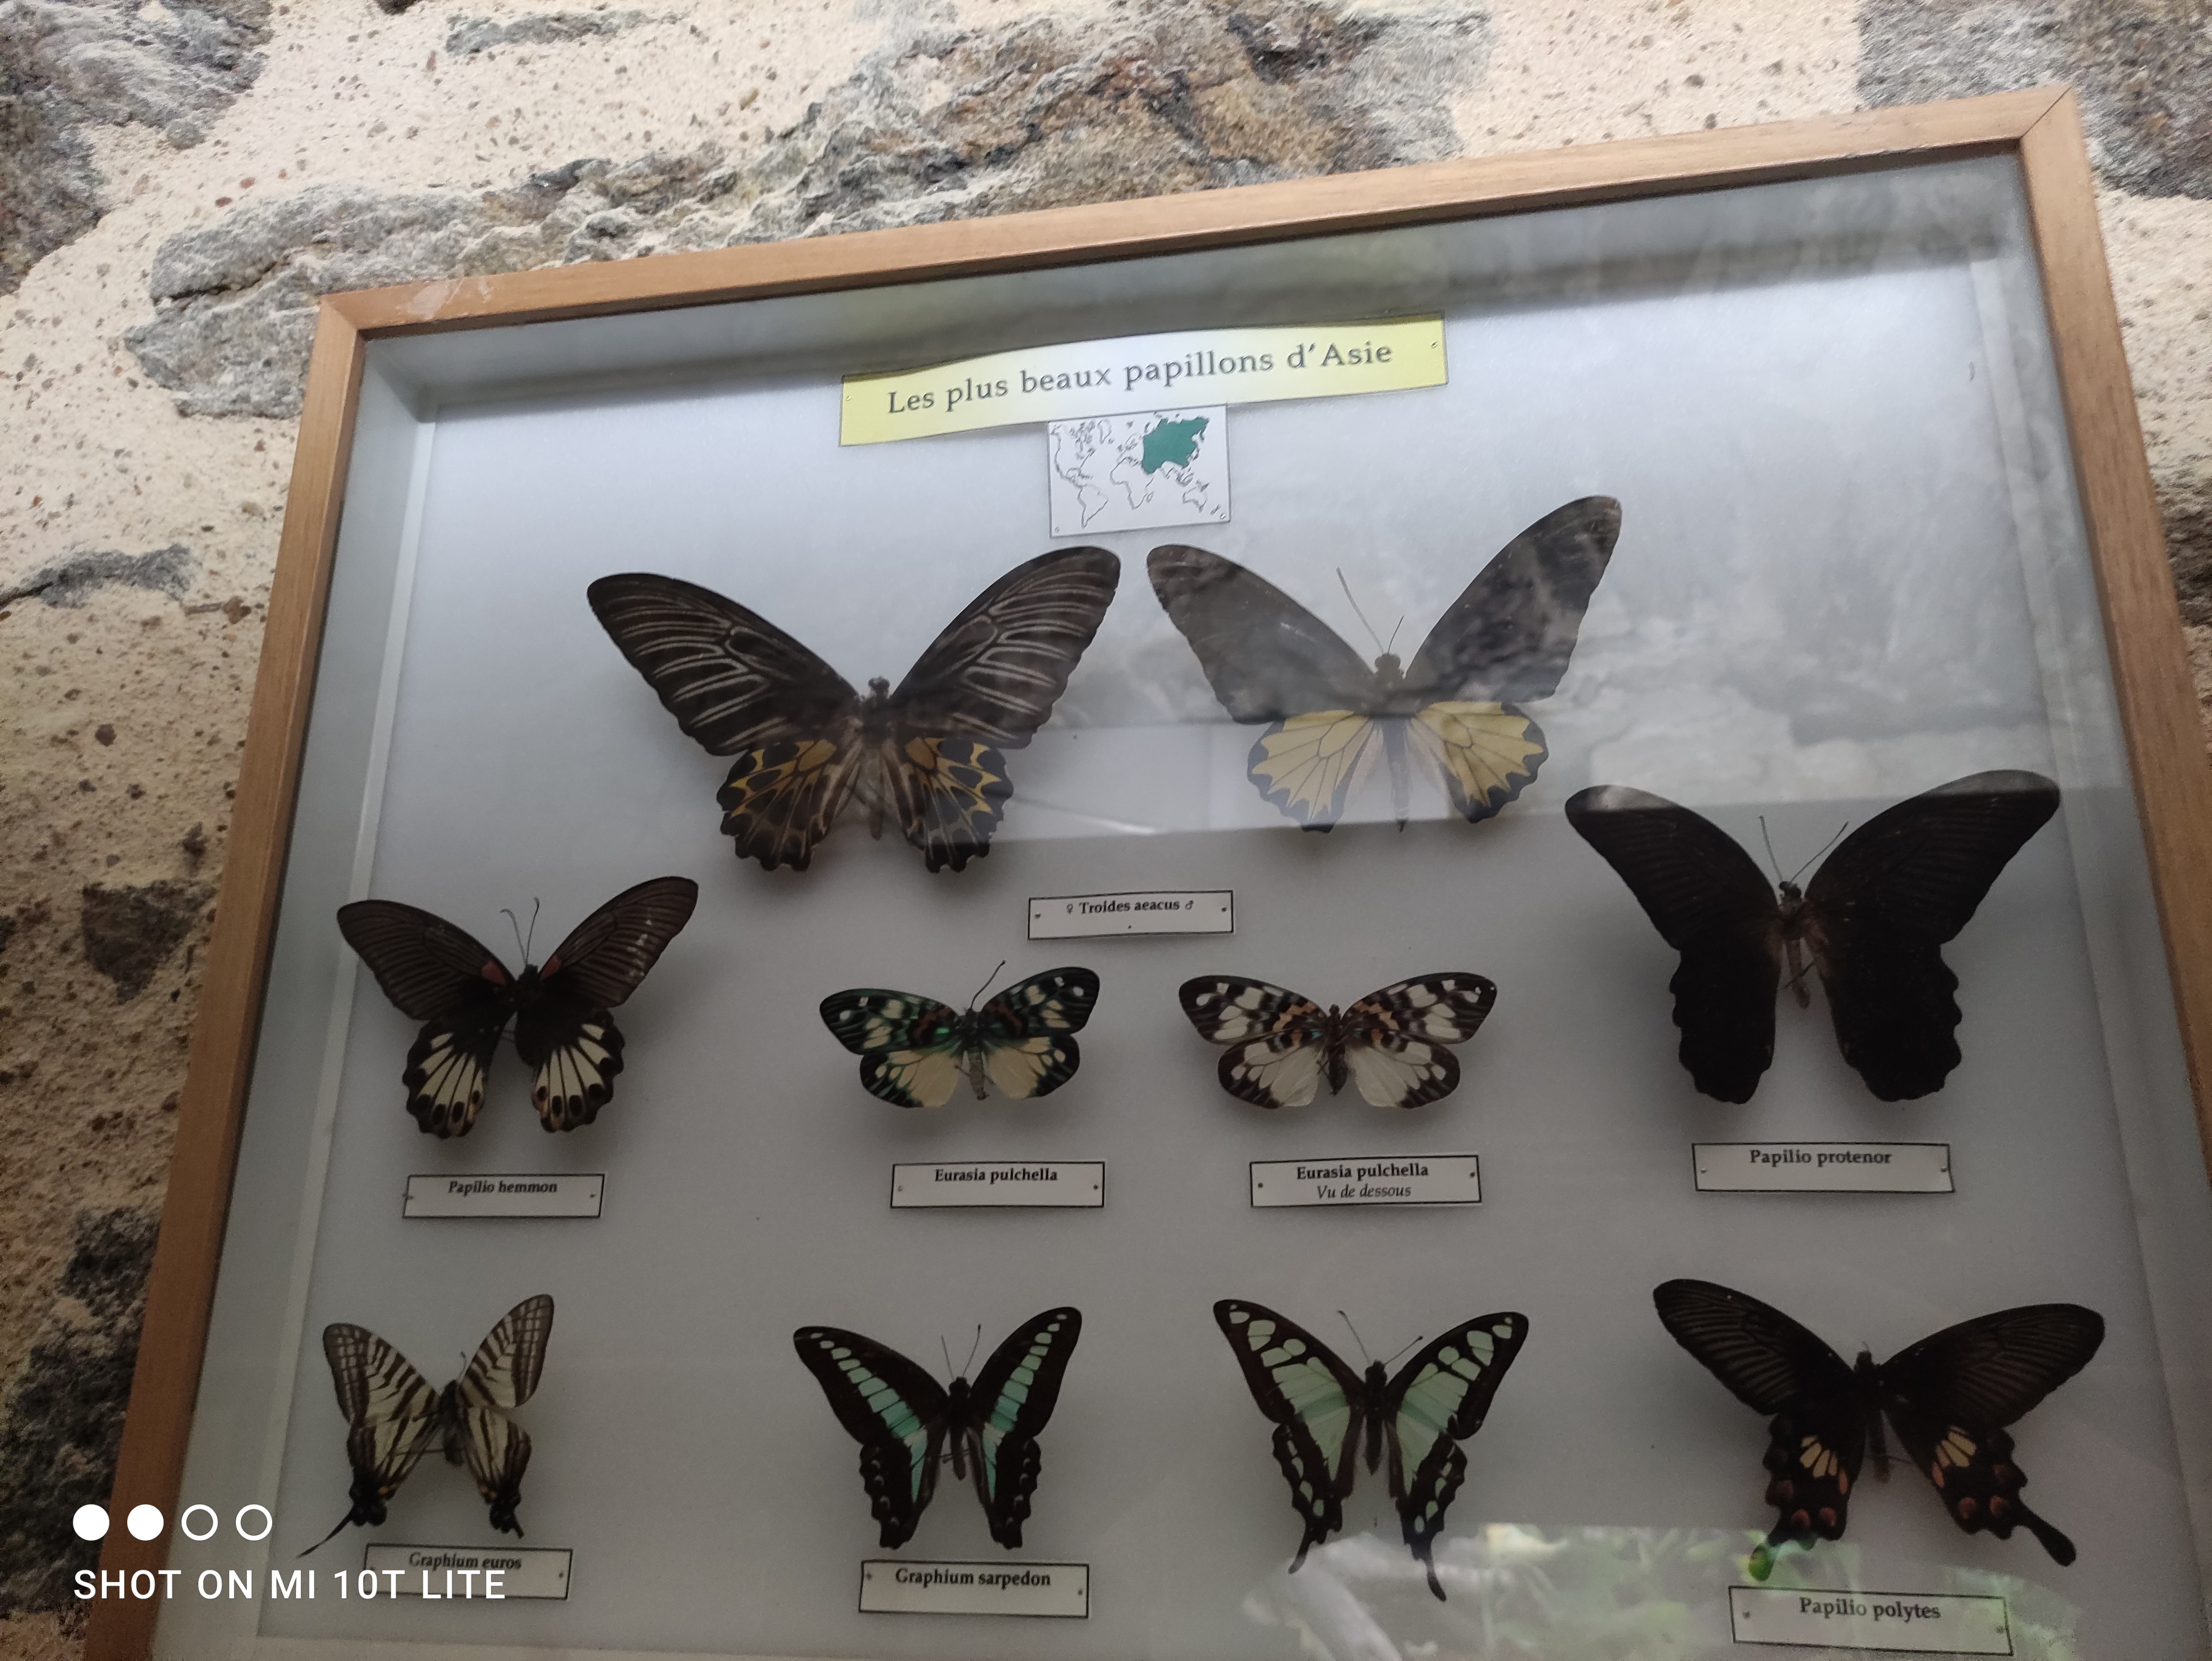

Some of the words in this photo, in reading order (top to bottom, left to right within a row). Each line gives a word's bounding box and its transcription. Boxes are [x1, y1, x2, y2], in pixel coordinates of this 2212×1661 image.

[887, 390, 935, 414] Les
[946, 378, 1009, 412] plus
[1022, 366, 1112, 393] beaux
[1125, 349, 1274, 389] papillons
[1079, 900, 1130, 914] Troides
[1134, 901, 1180, 910] aeacus
[1750, 1149, 1812, 1167] Papilio
[1818, 1151, 1891, 1167] protenor
[935, 1168, 985, 1182] Eurasia
[989, 1167, 1057, 1185] pulchella
[1297, 1165, 1352, 1180] Eurasia
[1357, 1163, 1429, 1181] pulchella
[448, 1180, 495, 1196] Papilio
[498, 1180, 557, 1193] hemmon
[1317, 1185, 1336, 1198] Vu
[1340, 1184, 1355, 1198] de
[1360, 1184, 1411, 1197] dessous
[409, 1551, 478, 1572] Graphium
[482, 1558, 521, 1571] euros
[896, 1568, 973, 1588] Graphium
[978, 1570, 1051, 1590] sarpedon
[1800, 1597, 1866, 1619] Papilio
[1873, 1601, 1941, 1623] polytes
